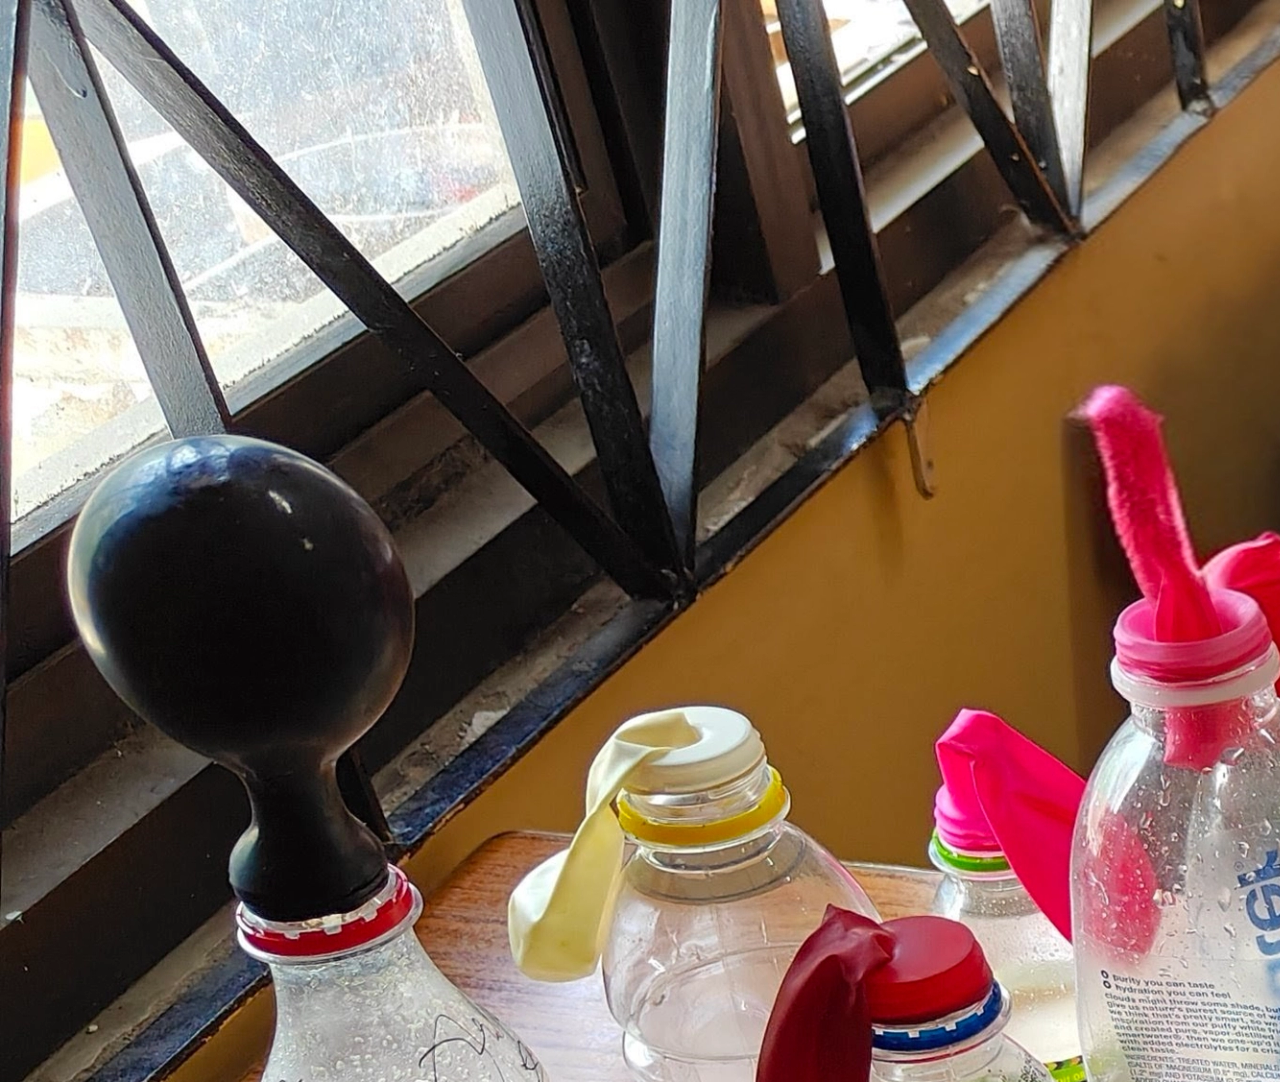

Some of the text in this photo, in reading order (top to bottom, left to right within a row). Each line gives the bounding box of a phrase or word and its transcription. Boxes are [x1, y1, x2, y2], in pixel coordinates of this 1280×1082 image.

[1112, 974, 1215, 990] purity you can taste
[1115, 983, 1165, 996] hydration
[1210, 991, 1232, 1000] feel
